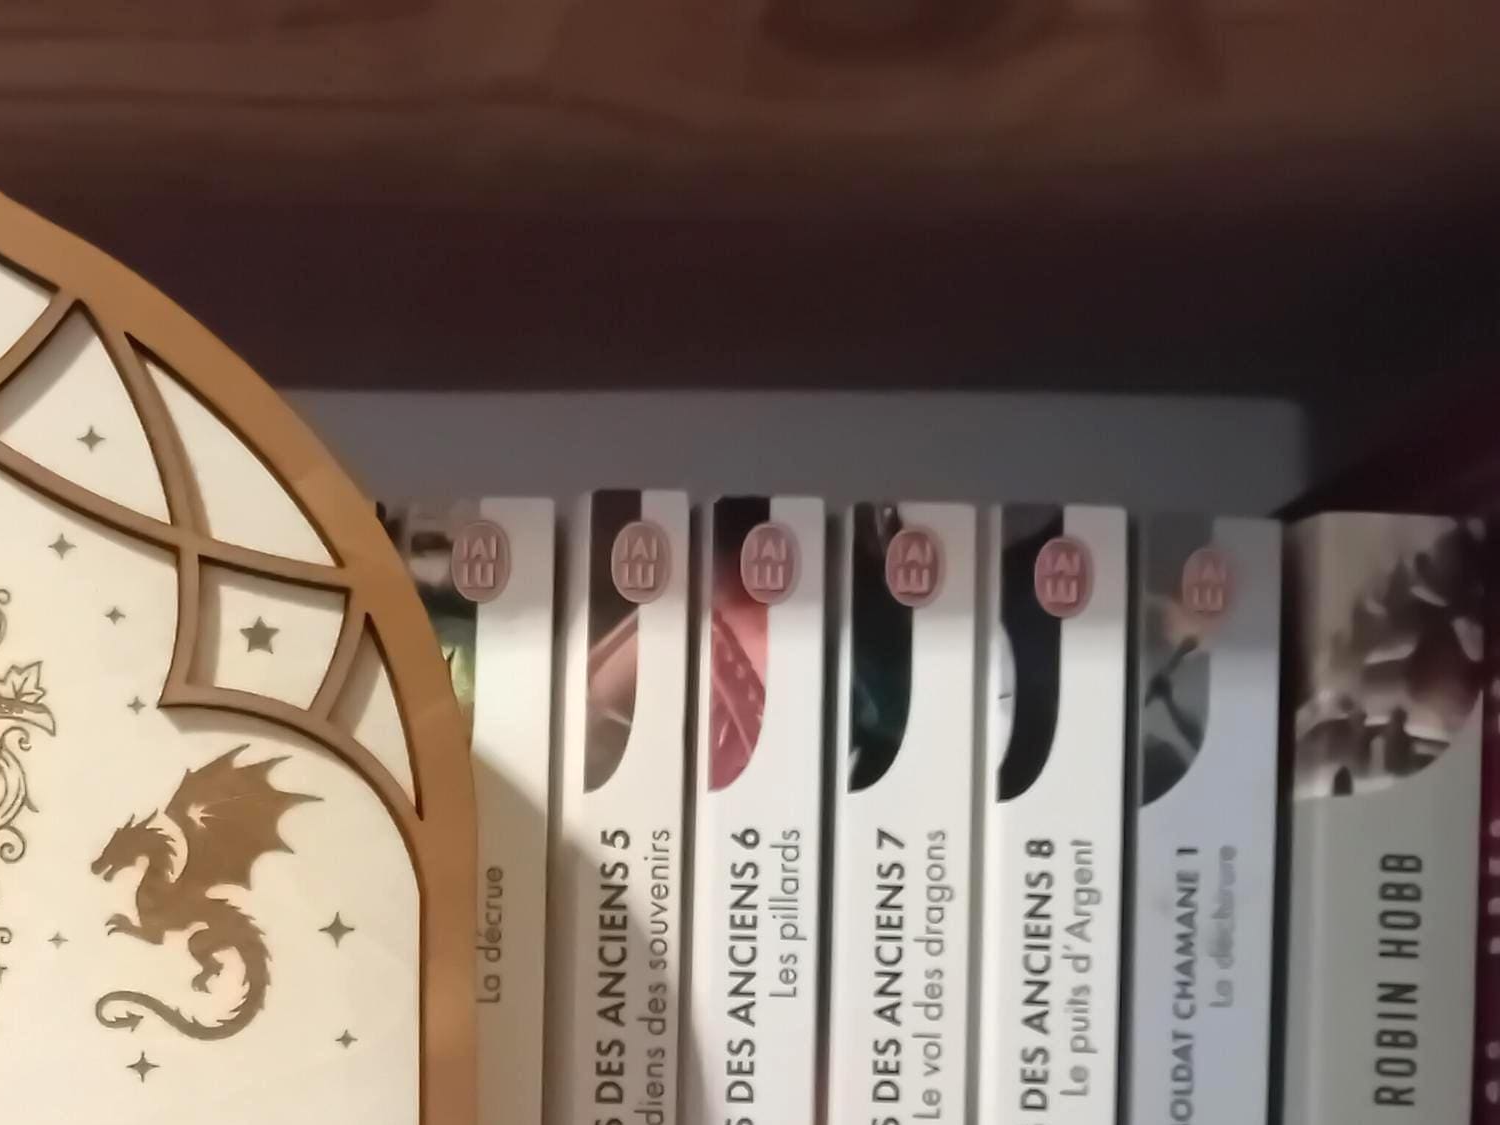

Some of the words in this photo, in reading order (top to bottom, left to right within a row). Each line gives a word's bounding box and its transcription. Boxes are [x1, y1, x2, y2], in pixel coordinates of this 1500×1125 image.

[601, 828, 630, 850] 5
[731, 827, 760, 850] 6
[876, 827, 906, 849] 7
[1025, 837, 1054, 858] 8
[1175, 846, 1199, 855] 1
[476, 865, 504, 962] décrue
[643, 828, 671, 969] souvenirs
[769, 828, 807, 940] pillards
[913, 829, 953, 956] dragons
[1378, 852, 1423, 958] HOBB
[597, 861, 629, 1026] ANCIENS
[728, 861, 759, 1026] ANCIENS
[769, 952, 799, 997] Les
[874, 861, 905, 1026] ANCIENS
[1022, 870, 1054, 1034] ANCIENS
[1172, 869, 1199, 1019] CHAMANE
[476, 973, 502, 1002] La
[637, 981, 668, 1034] des
[914, 968, 945, 1020] des
[1064, 983, 1097, 1053] puits
[596, 1038, 625, 1104] DES
[726, 1038, 756, 1103] DES
[872, 1037, 901, 1102] DES
[913, 1032, 943, 1076] vol
[1374, 981, 1418, 1105] ROBIN
[913, 1087, 942, 1118] Le
[1020, 1046, 1049, 1111] DES
[1060, 1064, 1089, 1095] Le
